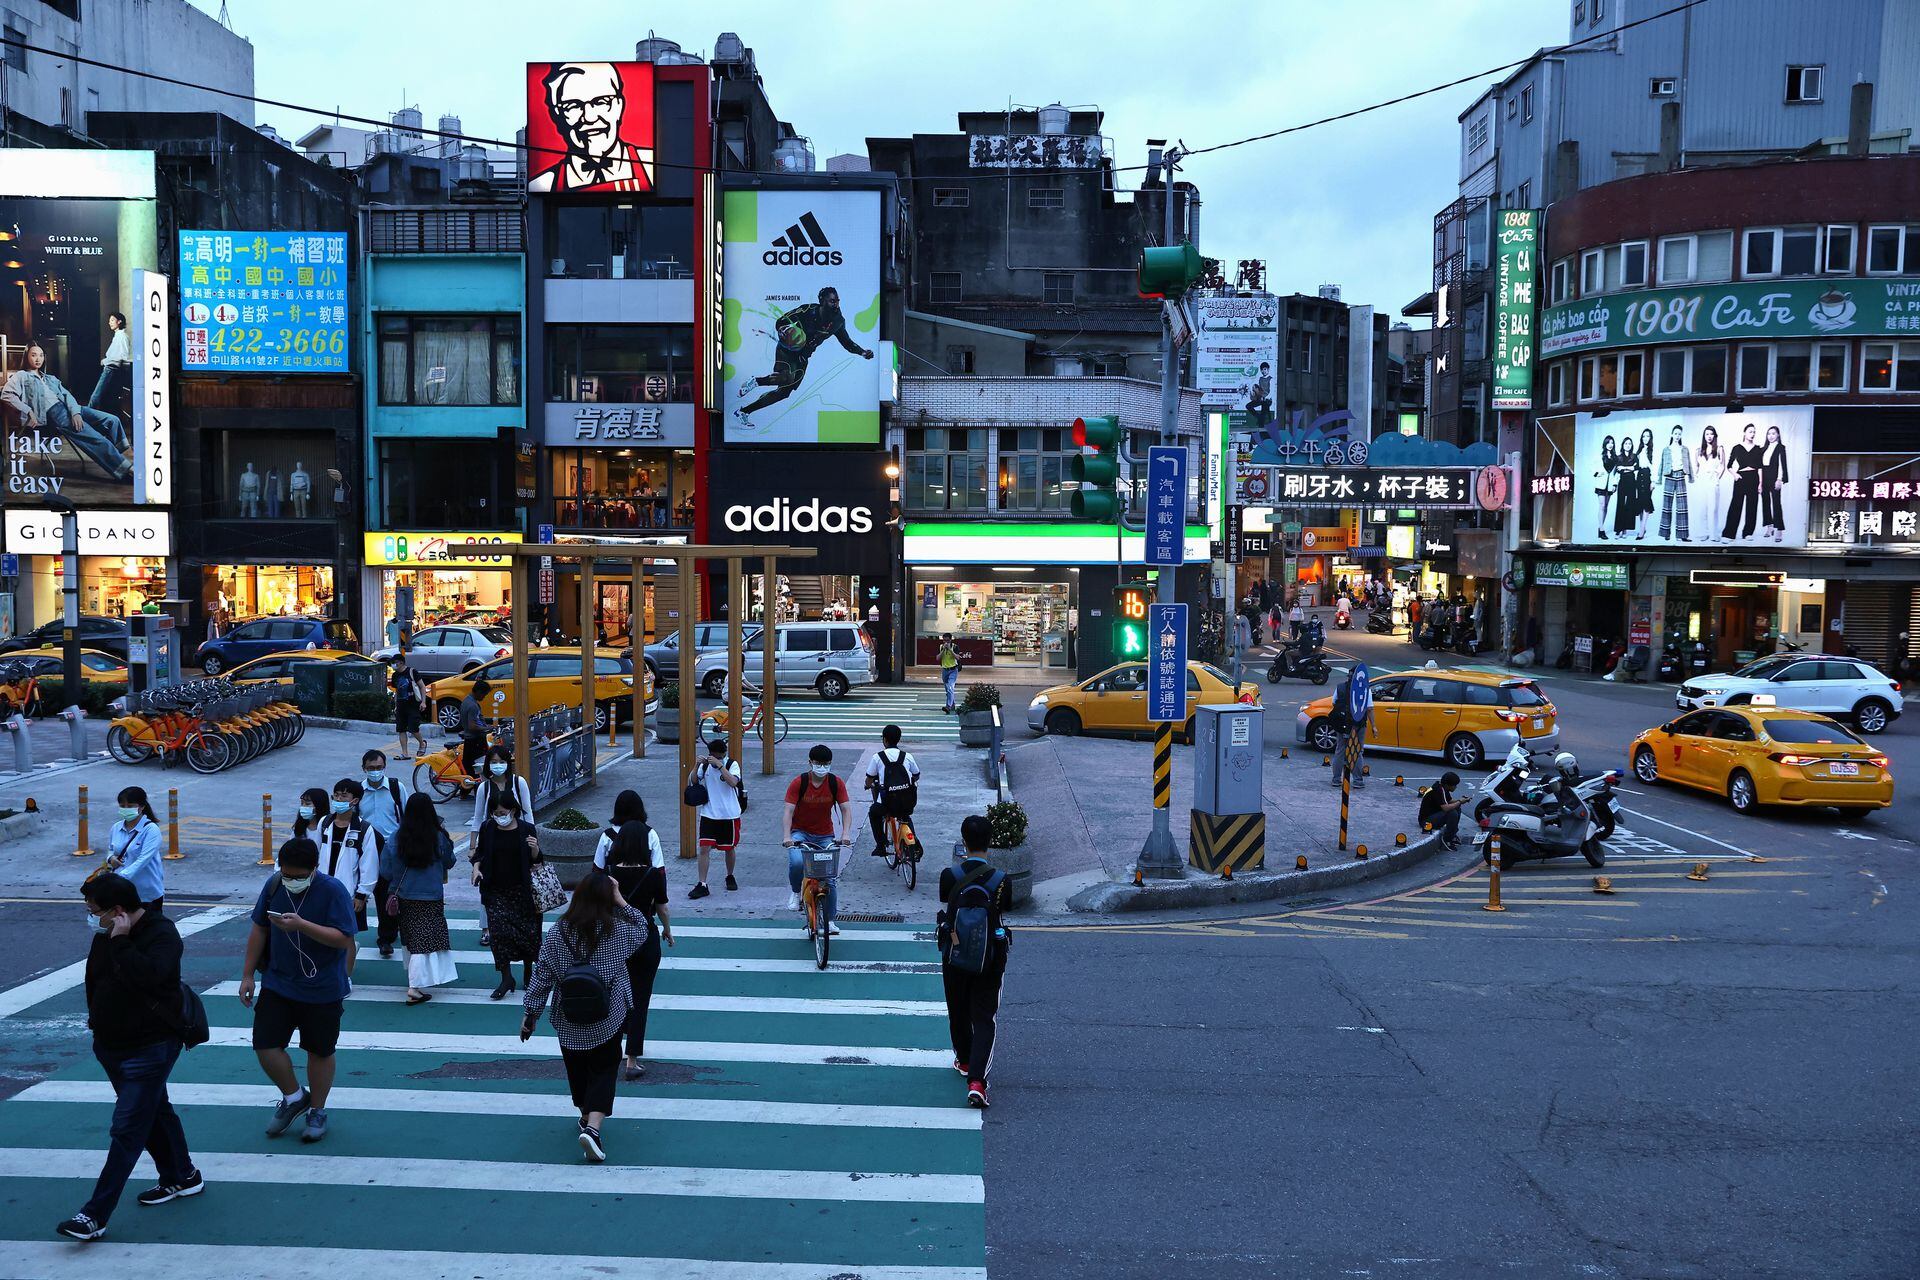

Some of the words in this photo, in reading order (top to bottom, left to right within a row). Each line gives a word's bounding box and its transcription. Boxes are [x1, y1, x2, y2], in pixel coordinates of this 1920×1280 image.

[1504, 212, 1531, 227] 1981
[45, 246, 72, 255] WHITE
[73, 246, 81, 255] &
[82, 246, 103, 256] BLUE
[48, 235, 99, 243] GIORDANO
[195, 236, 344, 264] 高明一對一補習班
[762, 245, 843, 266] adidas
[715, 220, 723, 370] adidas
[242, 304, 345, 324] 皆採一對一教學
[1623, 296, 1701, 337] 1981
[209, 328, 345, 354] 422-3666
[187, 348, 207, 363] 分校
[211, 355, 279, 366] 中山路141號2F
[283, 356, 343, 367] 近中壢火車站
[150, 290, 163, 487] GIORDANO
[574, 407, 662, 440] 肯德基
[8, 430, 63, 454] take
[10, 455, 27, 475] it
[1210, 453, 1219, 501] FamilyMart
[8, 475, 64, 495] easy
[724, 497, 873, 534] adidas
[1156, 478, 1175, 560] 汽車載客區
[1230, 519, 1238, 561] 中平路故事館
[1535, 562, 1552, 576] 1981
[1125, 592, 1144, 617] 16
[1159, 607, 1177, 718] 行人請依號誌通行
